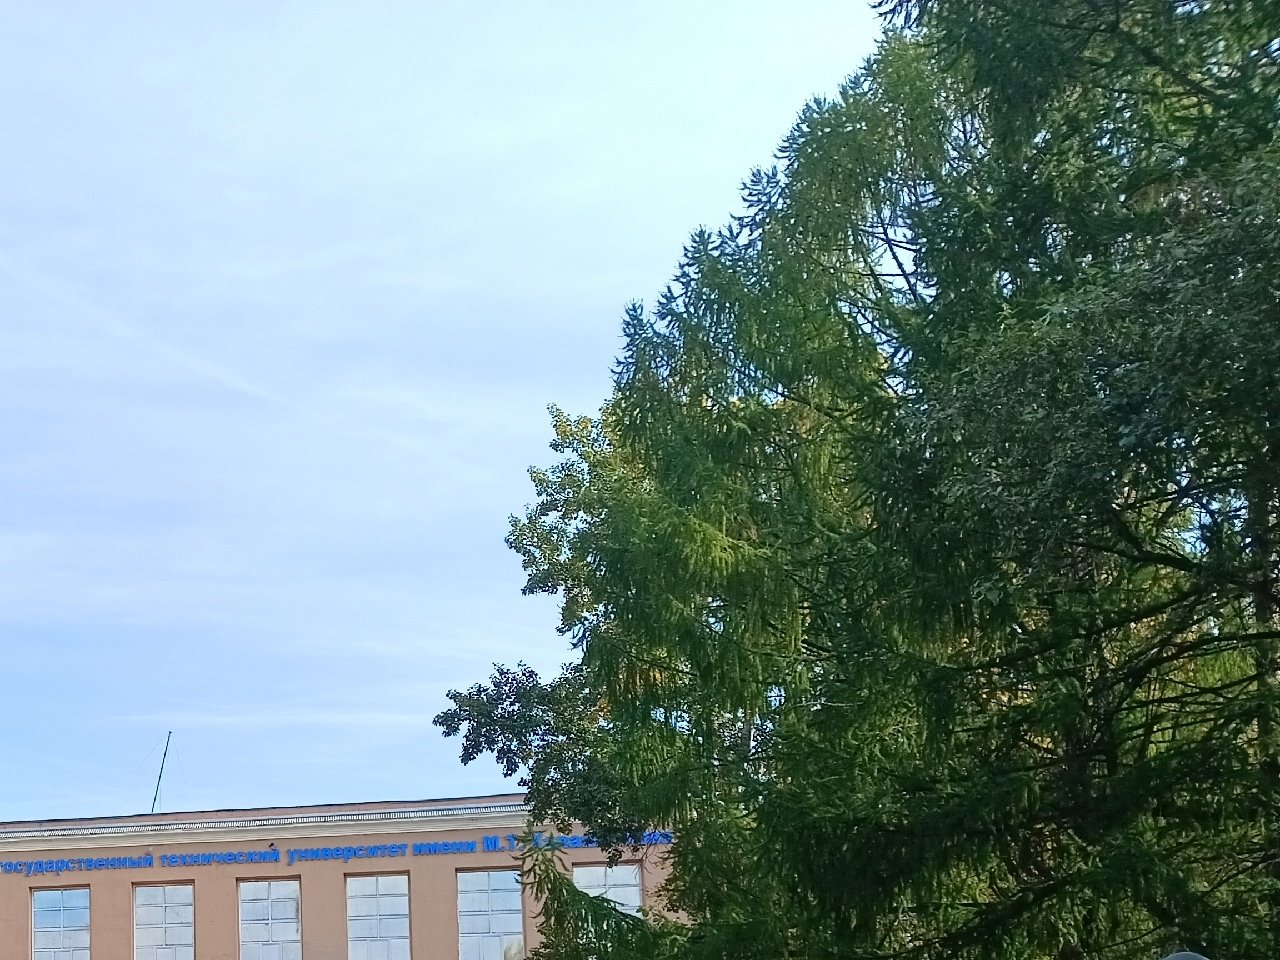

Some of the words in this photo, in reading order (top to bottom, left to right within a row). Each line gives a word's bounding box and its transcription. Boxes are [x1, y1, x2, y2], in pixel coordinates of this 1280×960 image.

[160, 847, 280, 868] технический
[287, 842, 408, 866] университет
[412, 841, 477, 856] имени
